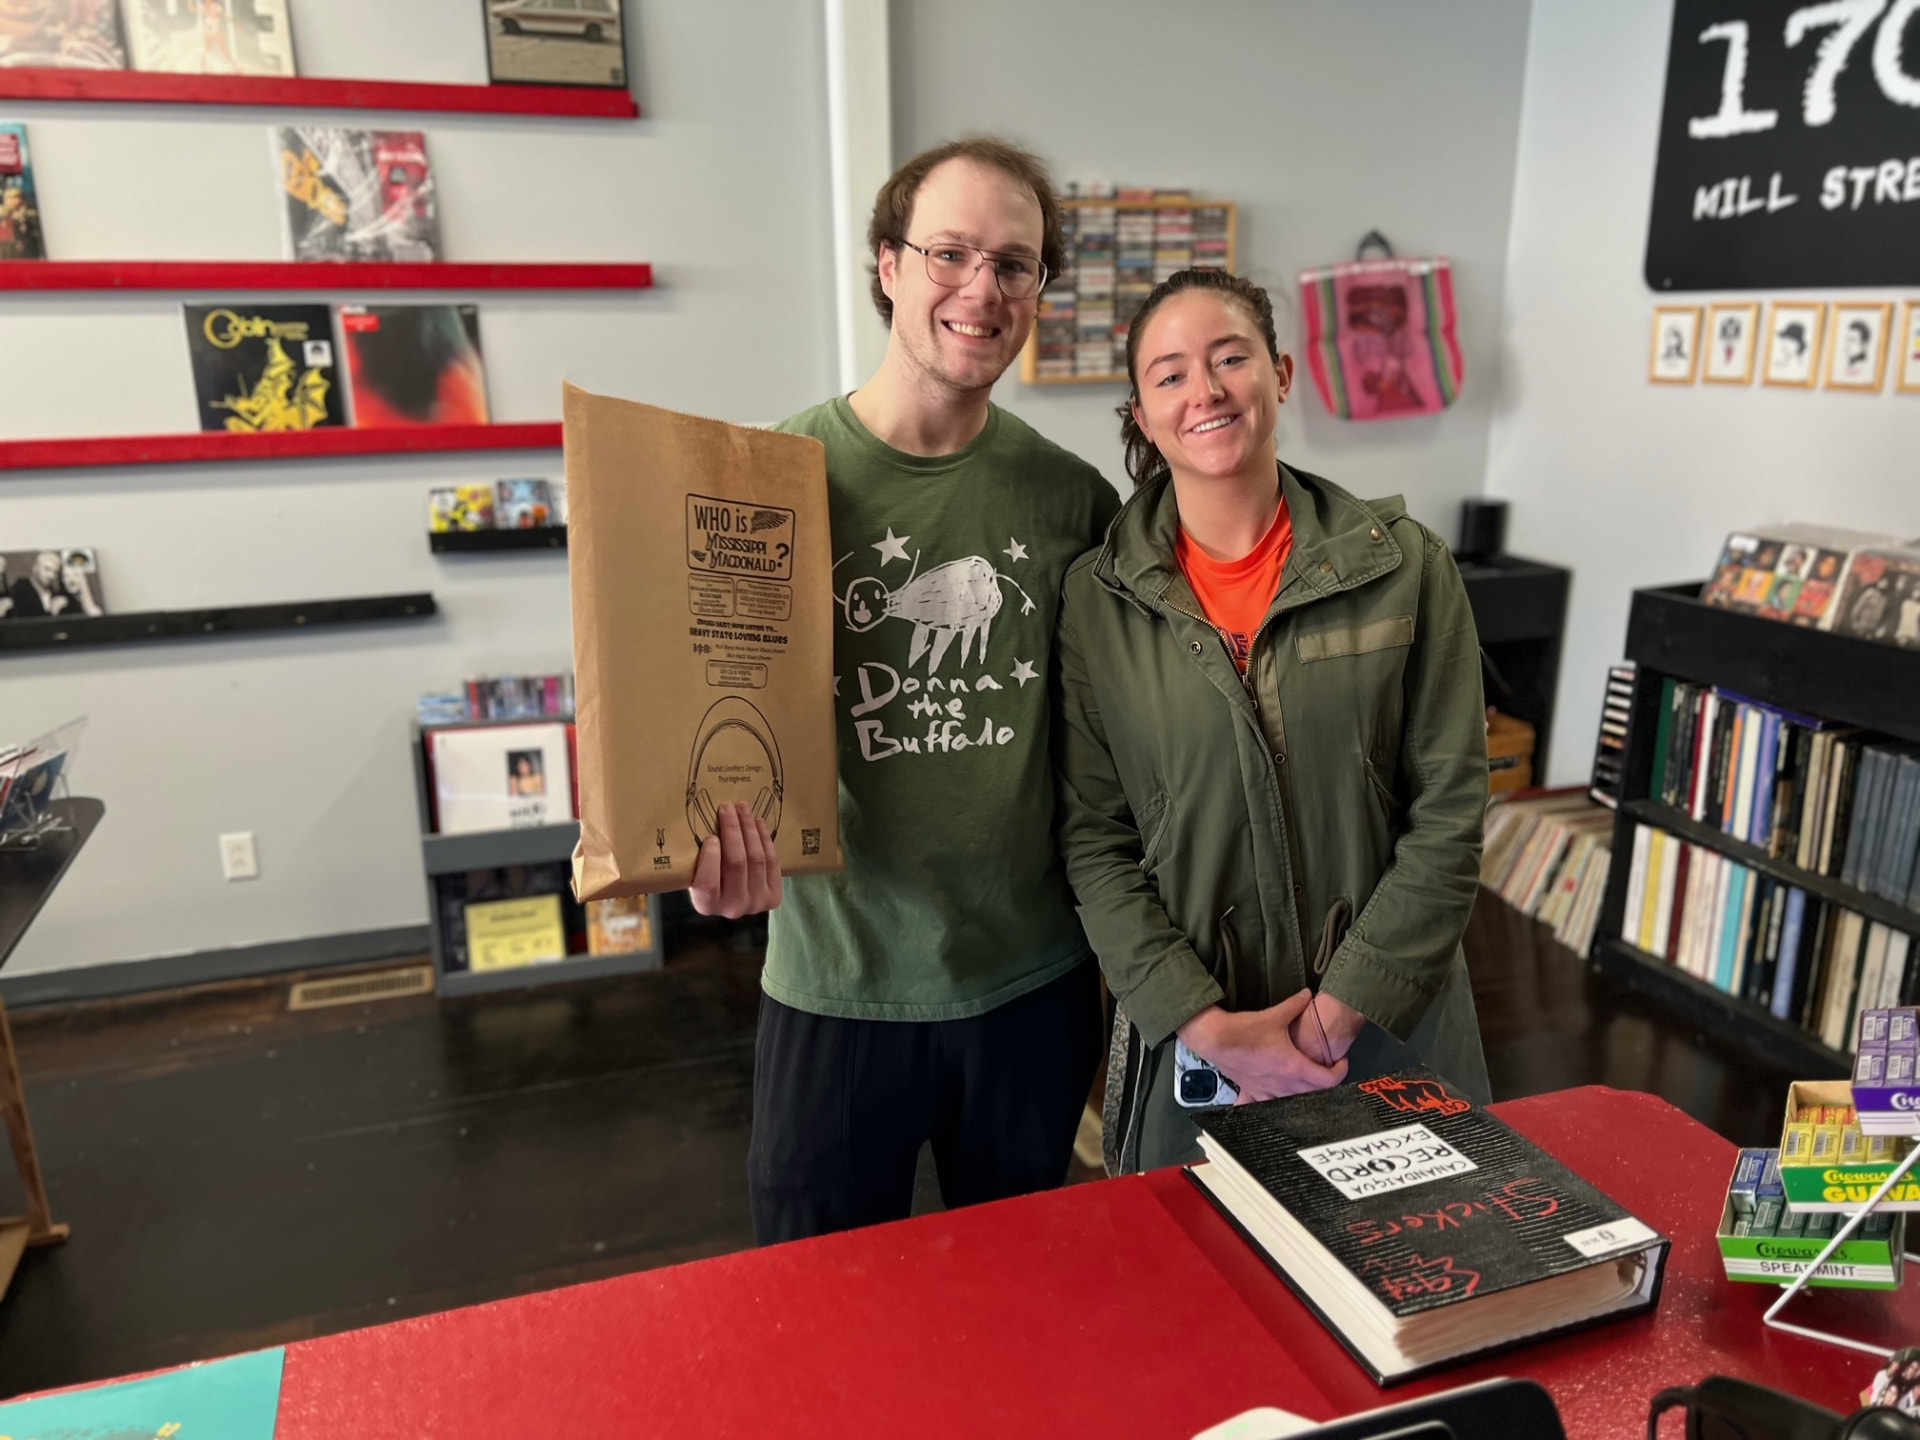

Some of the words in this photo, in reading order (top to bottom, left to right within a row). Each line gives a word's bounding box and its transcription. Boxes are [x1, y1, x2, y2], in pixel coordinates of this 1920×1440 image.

[1693, 171, 1798, 221] MILL
[693, 504, 731, 533] WHO
[736, 508, 748, 533] is
[851, 662, 1003, 717] Donna
[907, 693, 967, 720] the
[855, 717, 1015, 762] Buffalo
[1439, 1101, 1468, 1113] CAT
[1310, 1129, 1431, 1166] EXCHANGE
[1326, 1143, 1453, 1183] RECORD
[1350, 1160, 1468, 1196] CANANDAIGUA
[1823, 1169, 1913, 1184] Chowars
[1345, 1176, 1560, 1245] Stickers
[1756, 1242, 1848, 1259] Chowars
